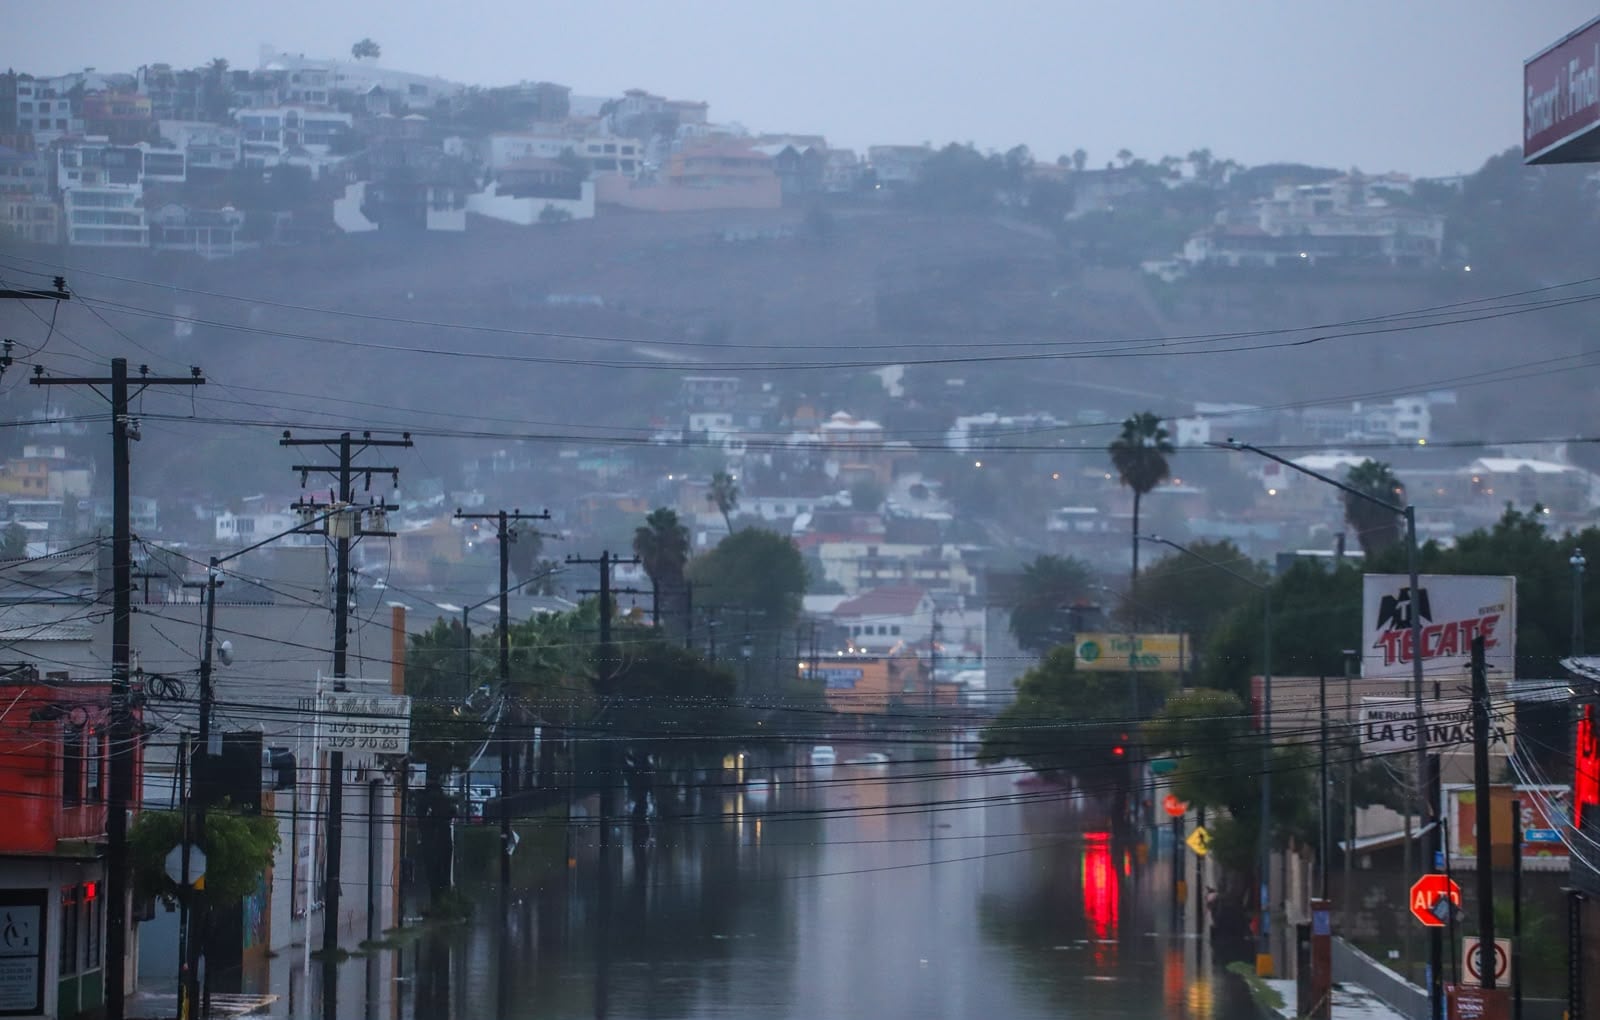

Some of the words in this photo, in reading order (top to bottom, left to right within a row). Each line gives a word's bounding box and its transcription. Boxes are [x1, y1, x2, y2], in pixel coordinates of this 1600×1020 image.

[1374, 615, 1500, 666] TECATE
[1368, 711, 1417, 720] MERCAD
[1367, 724, 1395, 741] LA
